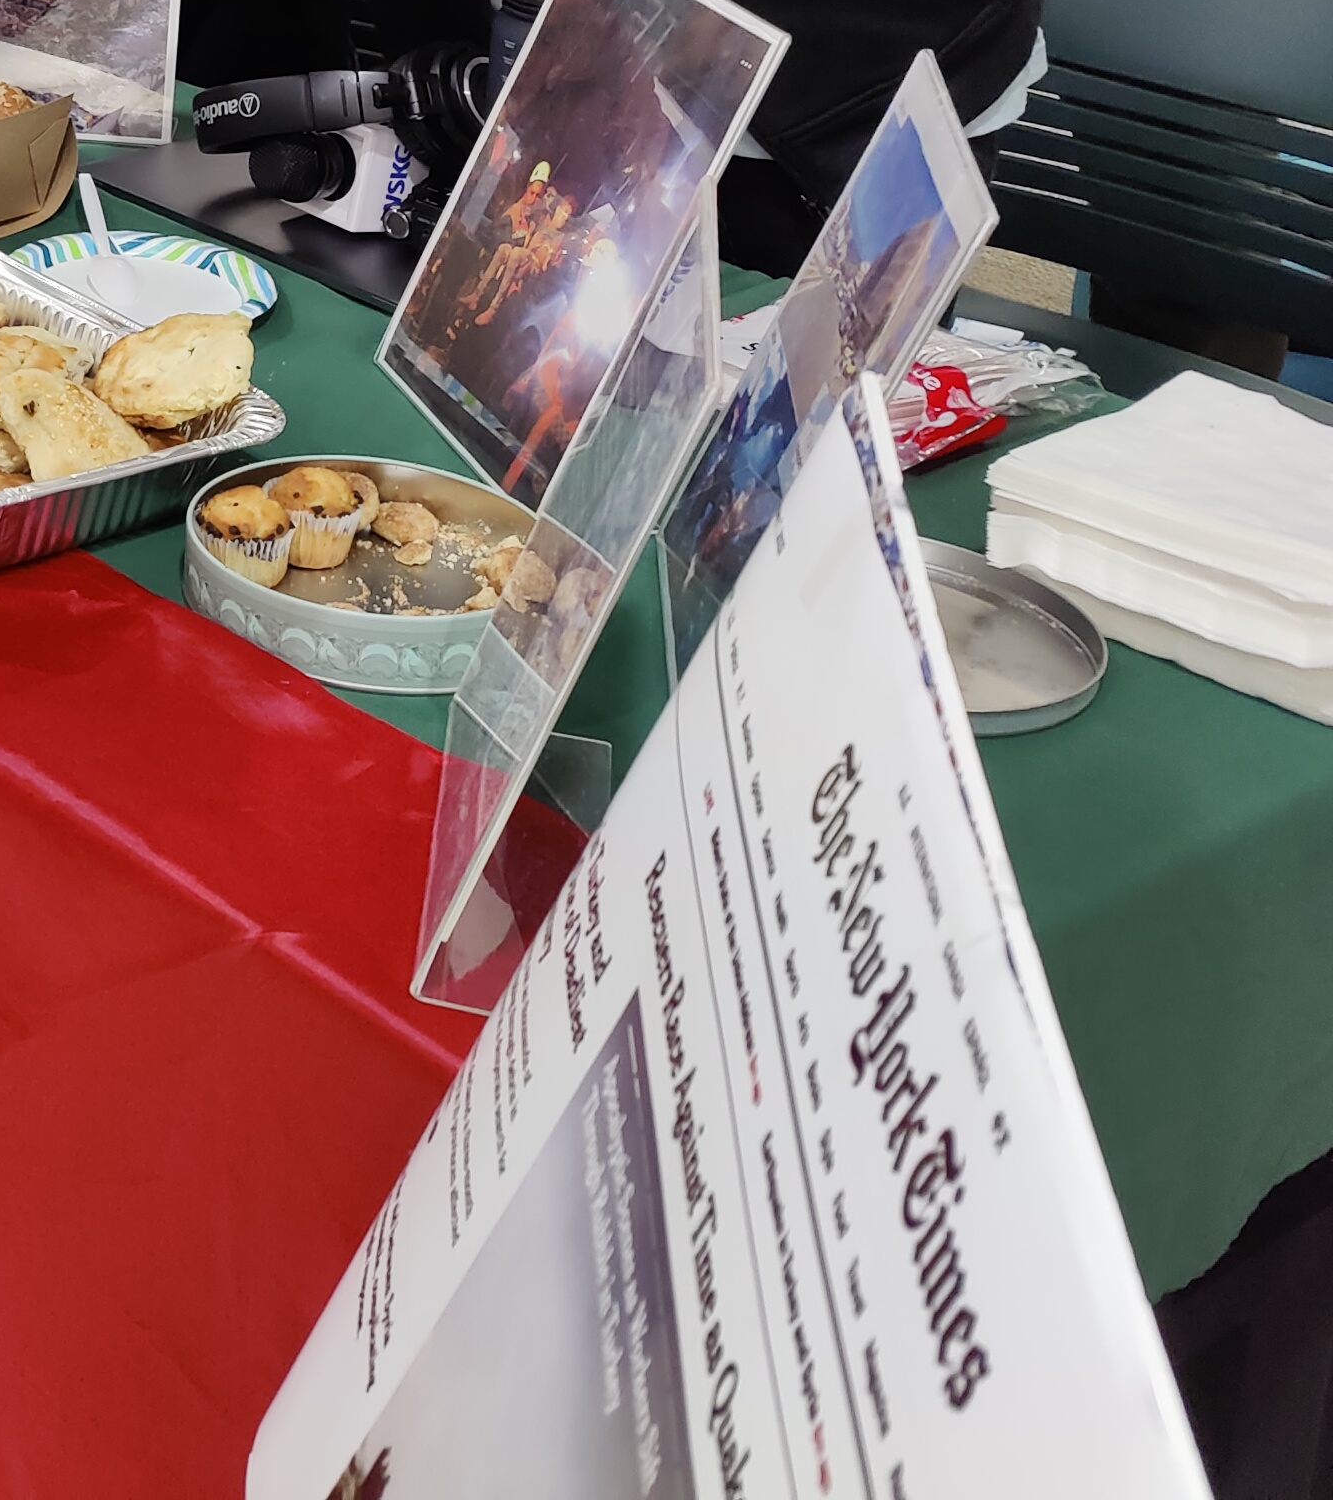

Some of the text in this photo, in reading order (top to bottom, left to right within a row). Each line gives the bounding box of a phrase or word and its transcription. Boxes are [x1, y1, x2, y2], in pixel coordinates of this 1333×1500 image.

[585, 841, 606, 937] Turkey
[644, 849, 674, 998] Rescuers
[563, 922, 587, 1054] Deadliest
[590, 931, 613, 986] and
[662, 976, 685, 1079] Race
[810, 743, 990, 1412] The New York Times
[580, 1083, 606, 1197] Through
[599, 1053, 631, 1198] Apocalyptic
[673, 1067, 707, 1217] Against
[588, 1183, 614, 1297] Rubble
[615, 1182, 635, 1281] Scenes
[691, 1192, 717, 1323] Time
[782, 1251, 799, 1324] Turkey
[600, 1303, 624, 1417] Turkey
[629, 1301, 651, 1438] Workers
[704, 1321, 723, 1375] as
[793, 1324, 810, 1365] and
[801, 1360, 819, 1422] Syria
[637, 1424, 661, 1496] Sift
